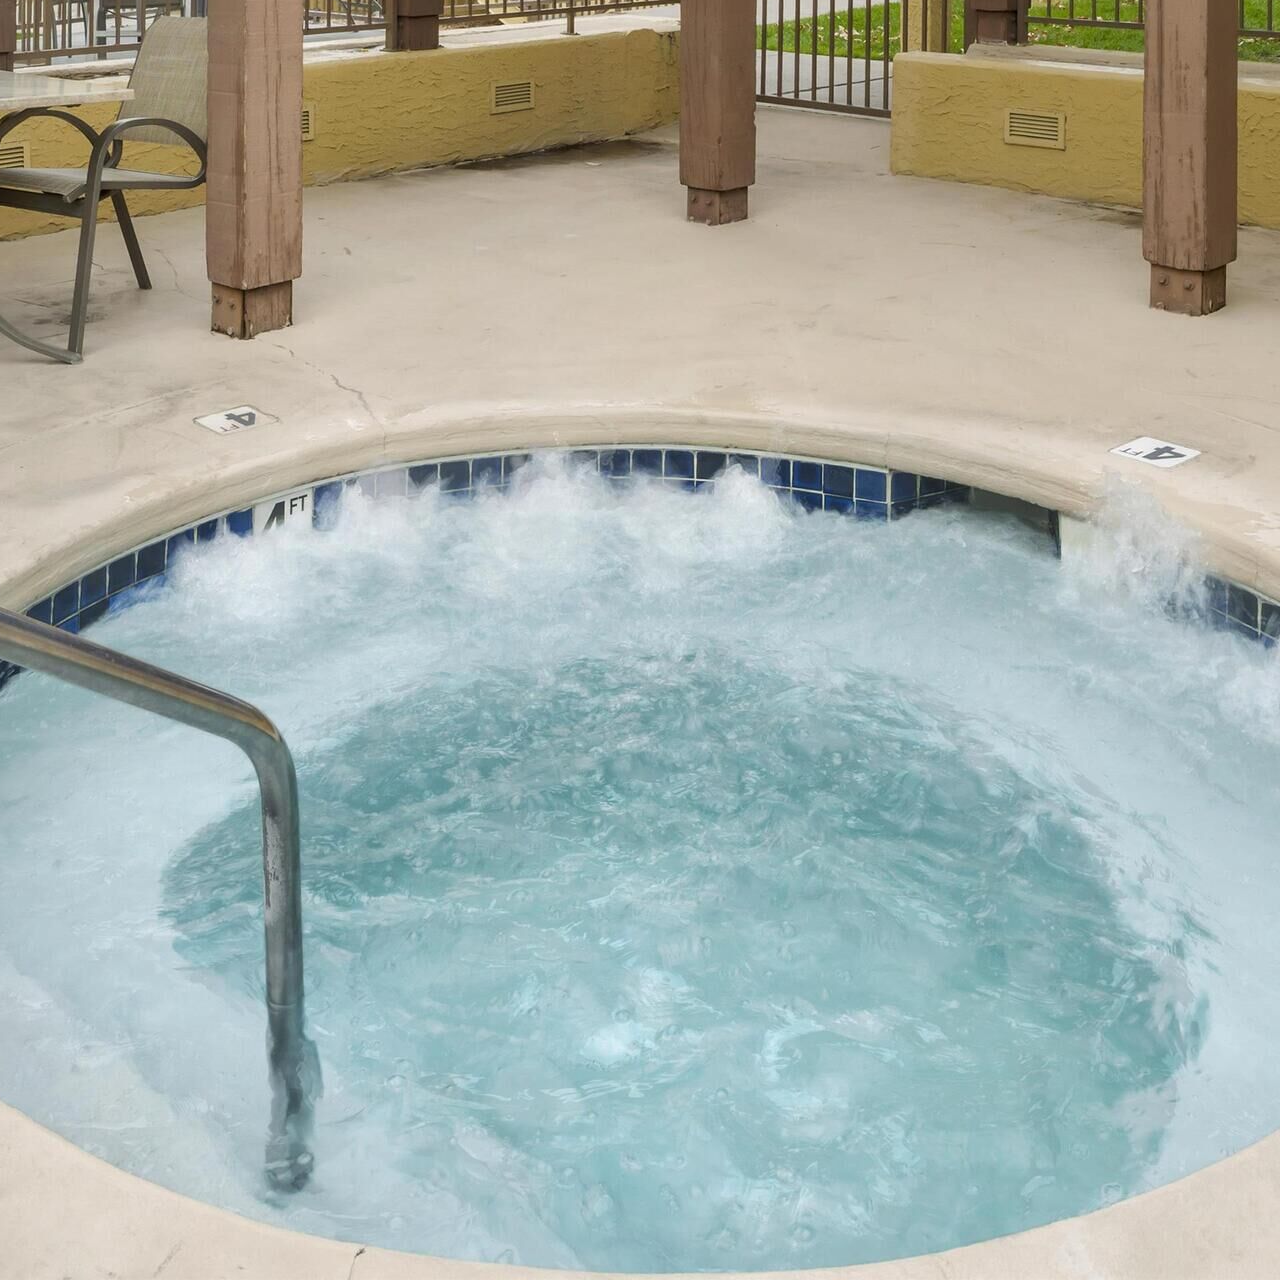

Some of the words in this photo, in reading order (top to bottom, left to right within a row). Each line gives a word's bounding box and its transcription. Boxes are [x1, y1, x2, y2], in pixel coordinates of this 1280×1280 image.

[223, 412, 256, 426] 4
[220, 423, 240, 432] FT
[1121, 448, 1144, 456] FT
[1142, 446, 1187, 460] 4
[289, 494, 308, 515] FT
